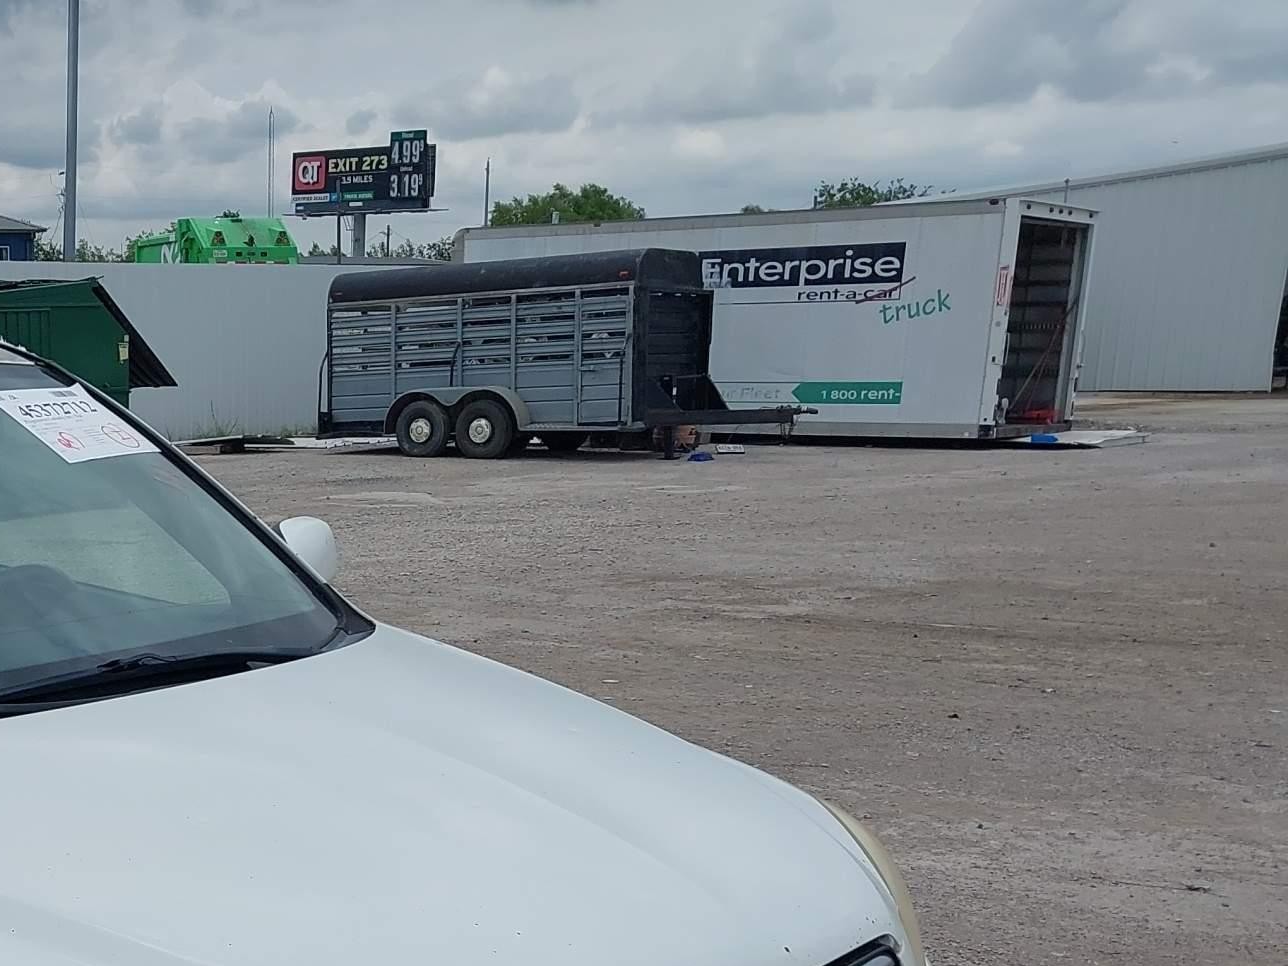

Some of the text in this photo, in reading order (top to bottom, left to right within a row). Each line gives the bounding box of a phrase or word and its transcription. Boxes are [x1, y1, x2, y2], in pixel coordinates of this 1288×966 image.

[328, 155, 388, 172] EXIT 273
[298, 161, 321, 184] QT
[353, 175, 373, 183] MILES
[702, 250, 901, 286] Enterprise
[797, 286, 898, 301] rent-a-car
[879, 289, 951, 324] truck
[821, 390, 826, 400] 1
[831, 390, 857, 400] 800
[18, 401, 98, 418] 45372712
